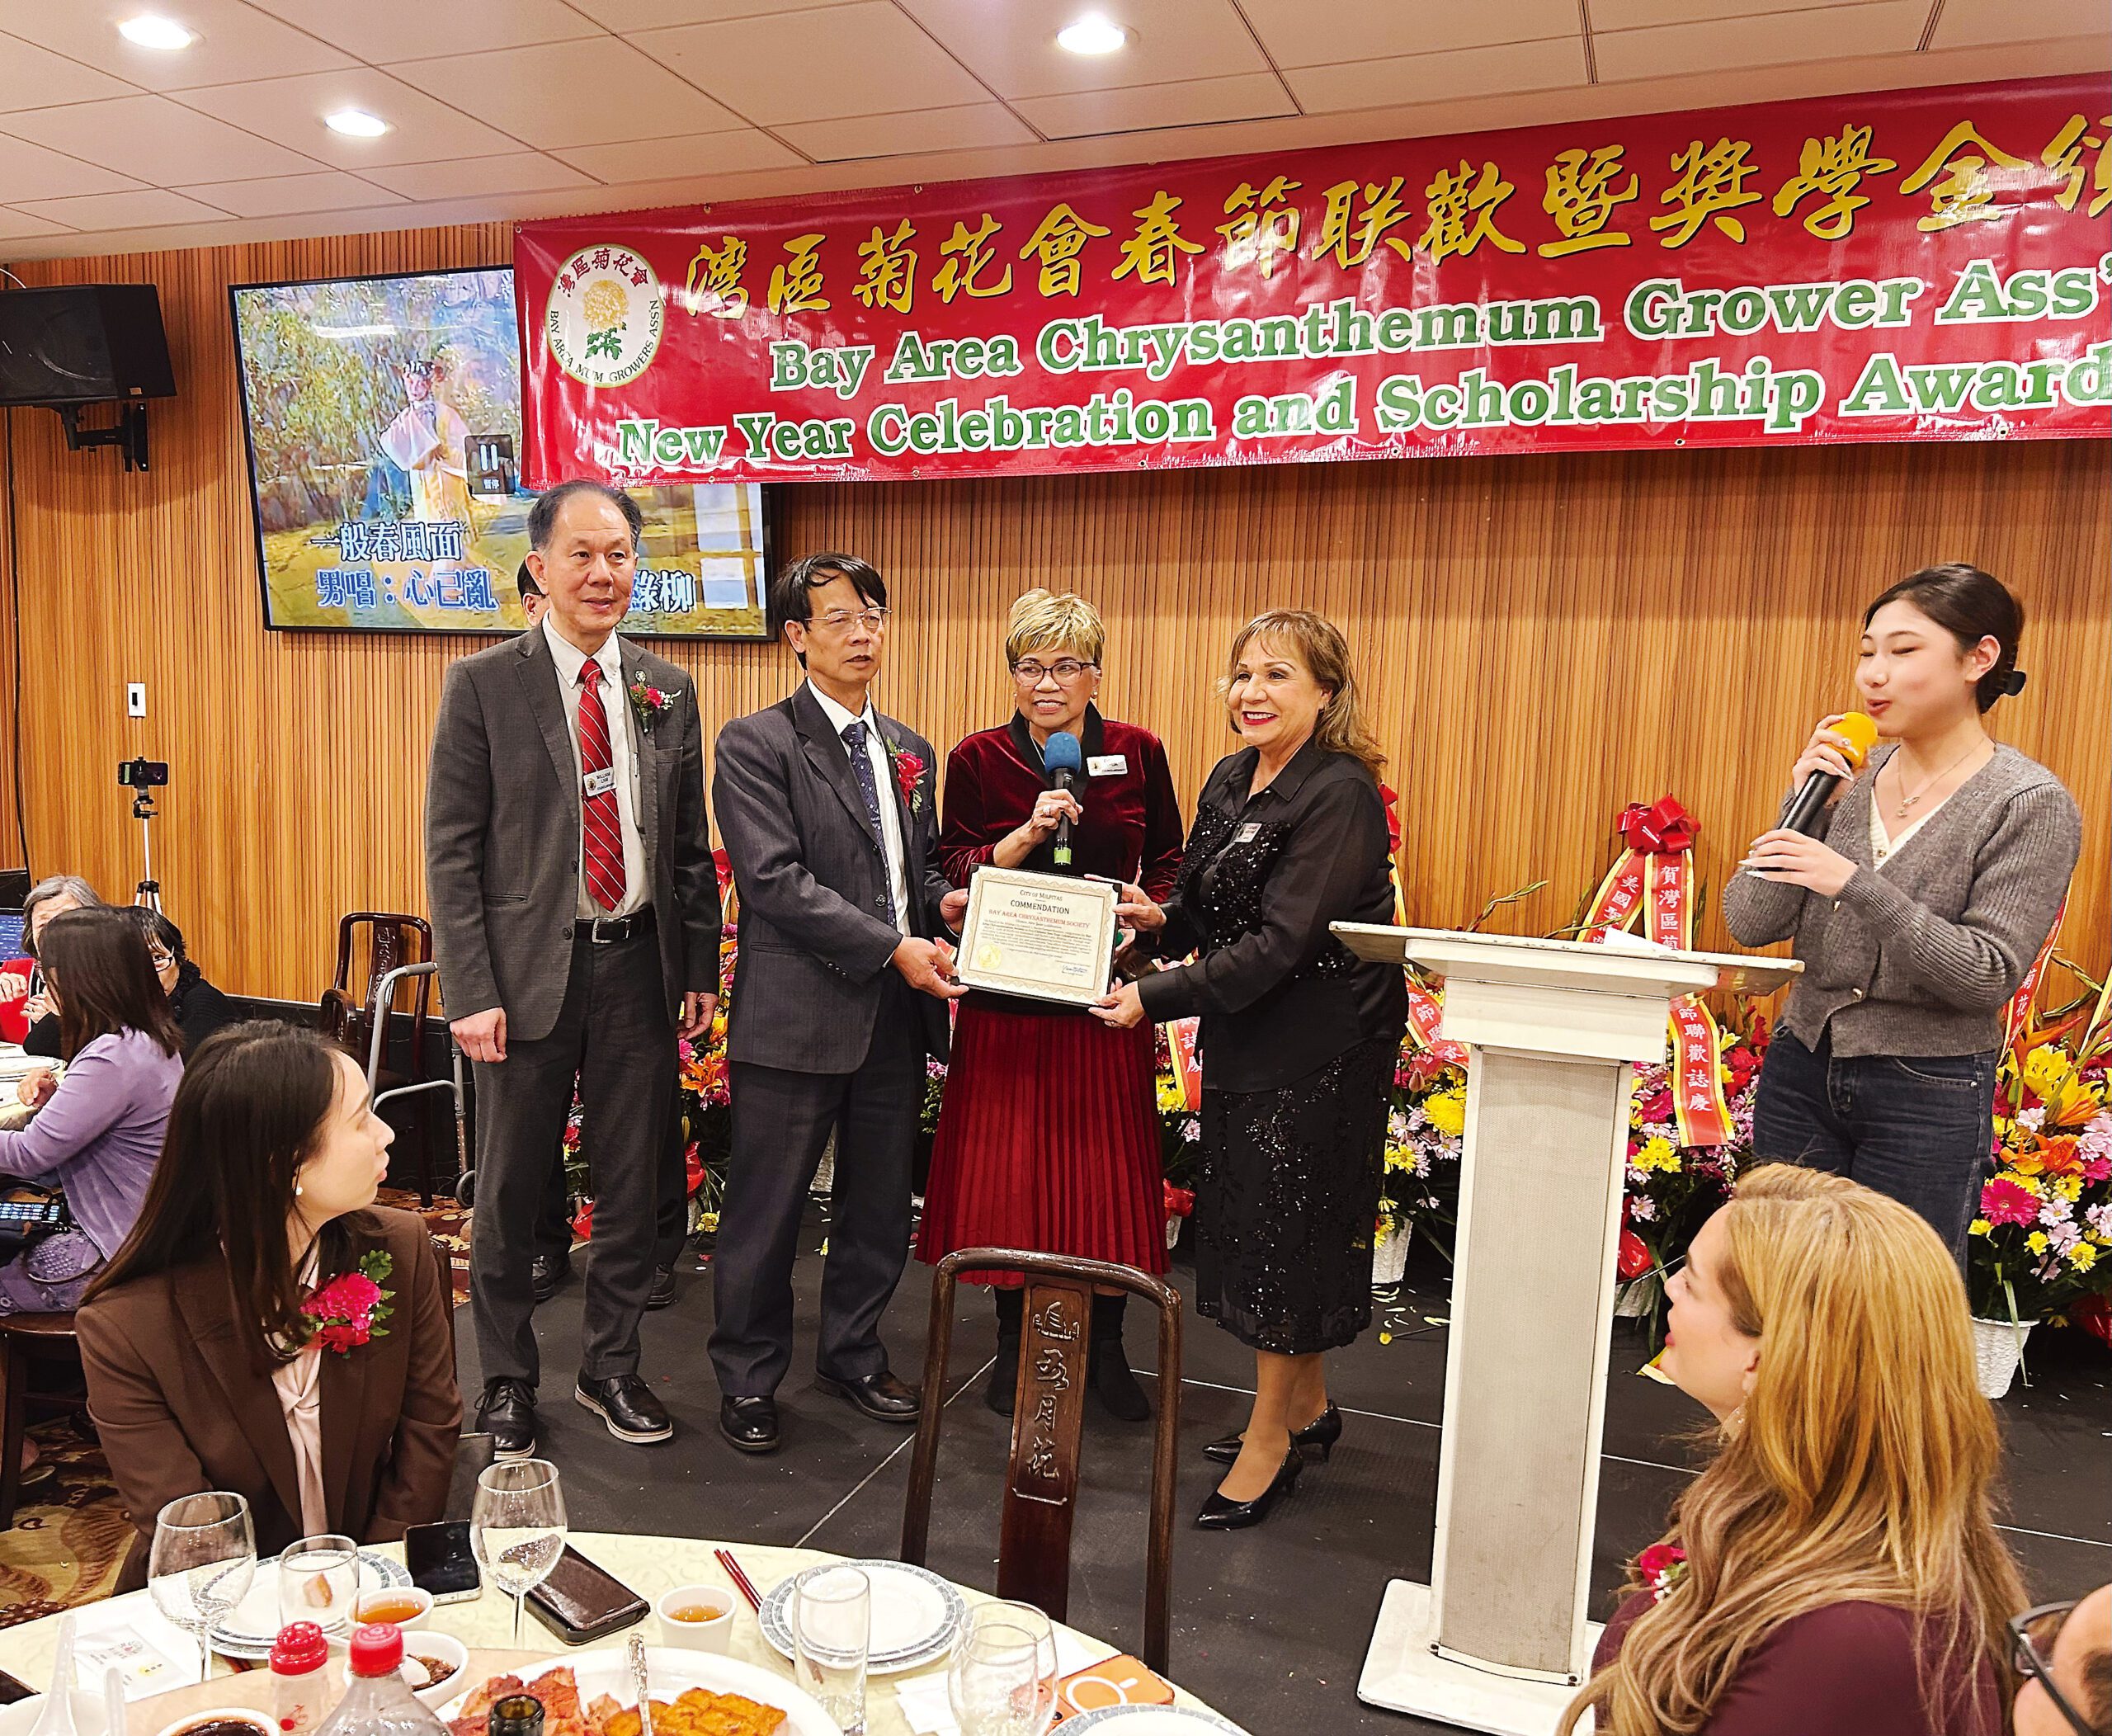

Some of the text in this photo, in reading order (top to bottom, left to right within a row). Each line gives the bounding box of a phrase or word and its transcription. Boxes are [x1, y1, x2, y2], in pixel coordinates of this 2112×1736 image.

[549, 310, 560, 334] BAY
[769, 339, 874, 401] Bay
[884, 330, 1024, 384] Area
[1035, 295, 1605, 382] Chrysanthemum
[1623, 276, 1925, 341] Grower
[553, 337, 574, 368] AREA
[609, 341, 654, 382] GROWERS
[615, 340, 2112, 467] New Year Celebration and Scholarship Award
[310, 521, 462, 562] 一般春風面
[1010, 899, 1070, 914] COMMENDATION
[1066, 920, 1091, 928] SOCIETY
